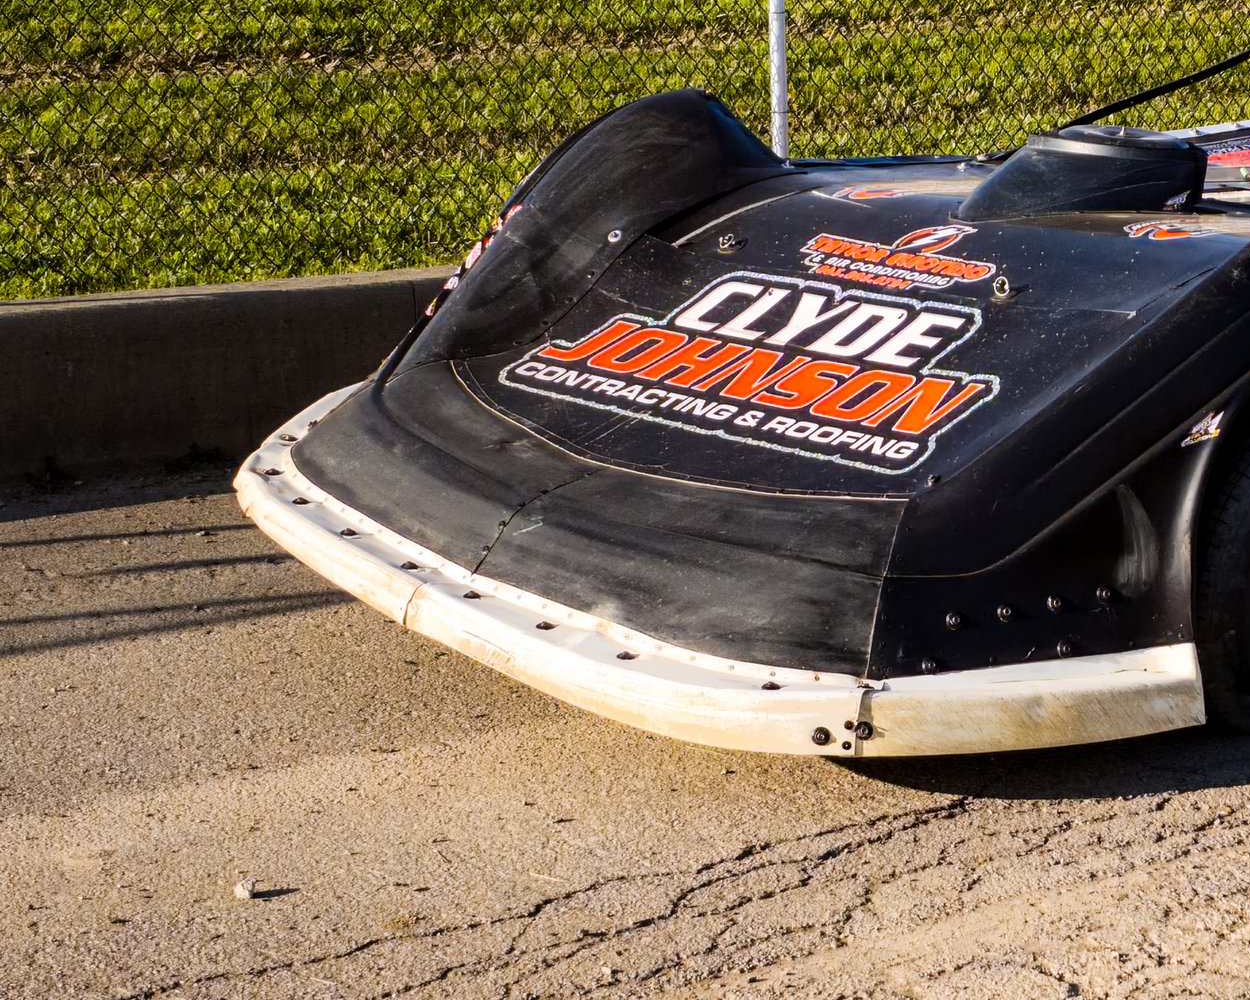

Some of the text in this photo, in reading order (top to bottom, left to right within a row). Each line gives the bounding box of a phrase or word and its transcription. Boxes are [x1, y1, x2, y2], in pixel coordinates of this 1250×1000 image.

[824, 256, 847, 268] AIR
[849, 262, 950, 285] CONDITIONING
[675, 281, 964, 367] CLYDE
[514, 361, 920, 460] CONTRACTING & ROOFING
[538, 320, 984, 435] JOHNSON
